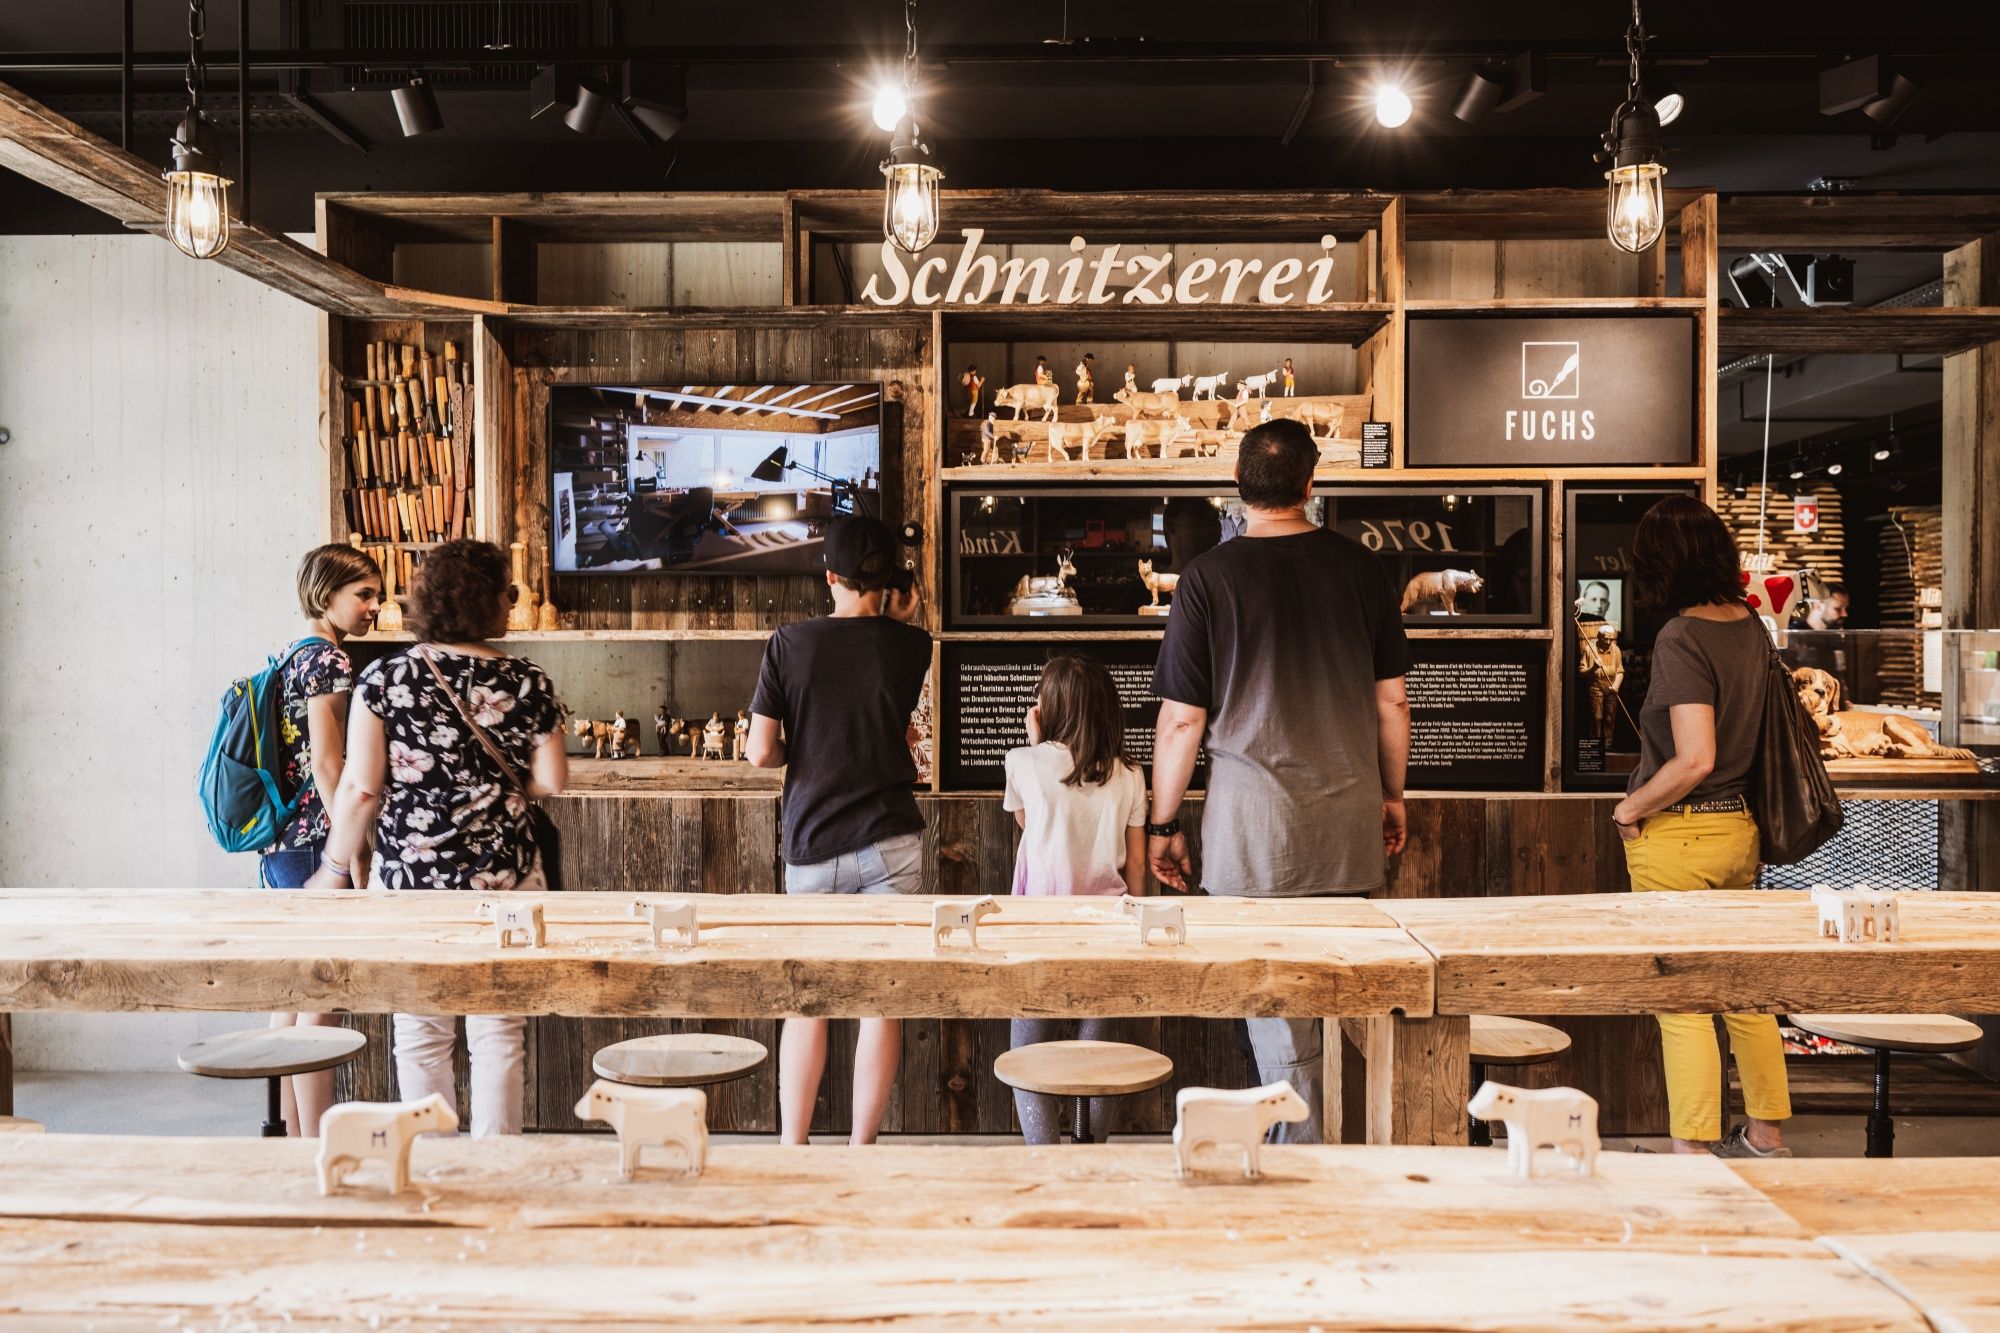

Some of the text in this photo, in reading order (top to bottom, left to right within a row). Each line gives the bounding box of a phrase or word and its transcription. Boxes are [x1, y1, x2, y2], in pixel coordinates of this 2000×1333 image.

[861, 228, 1336, 306] Schnitzerei
[1506, 410, 1595, 441] FUCHS
[961, 664, 1020, 673] Gebrauchsgegenstände
[961, 706, 984, 715] gründete
[961, 737, 1006, 746] Wirtschaftszweig
[507, 913, 516, 922] M
[1568, 1114, 1582, 1128] M
[371, 1130, 386, 1148] M
